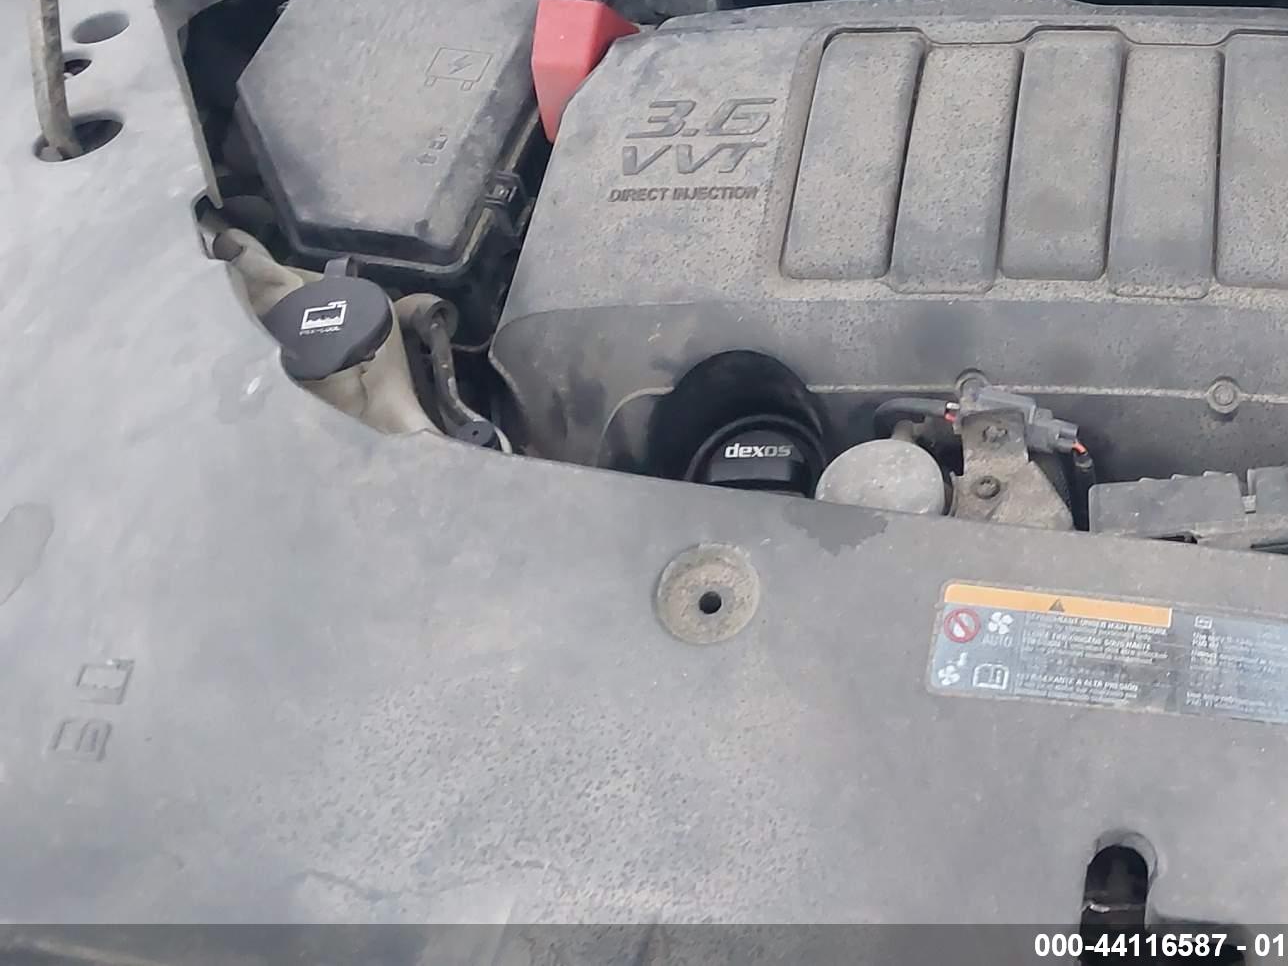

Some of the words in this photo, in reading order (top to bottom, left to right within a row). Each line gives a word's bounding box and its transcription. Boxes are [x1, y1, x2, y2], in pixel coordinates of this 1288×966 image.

[626, 97, 777, 139] 3.6
[622, 141, 767, 176] VVT
[608, 187, 669, 203] DIRECT
[672, 185, 759, 201] INJECTION
[724, 442, 794, 459] dexos
